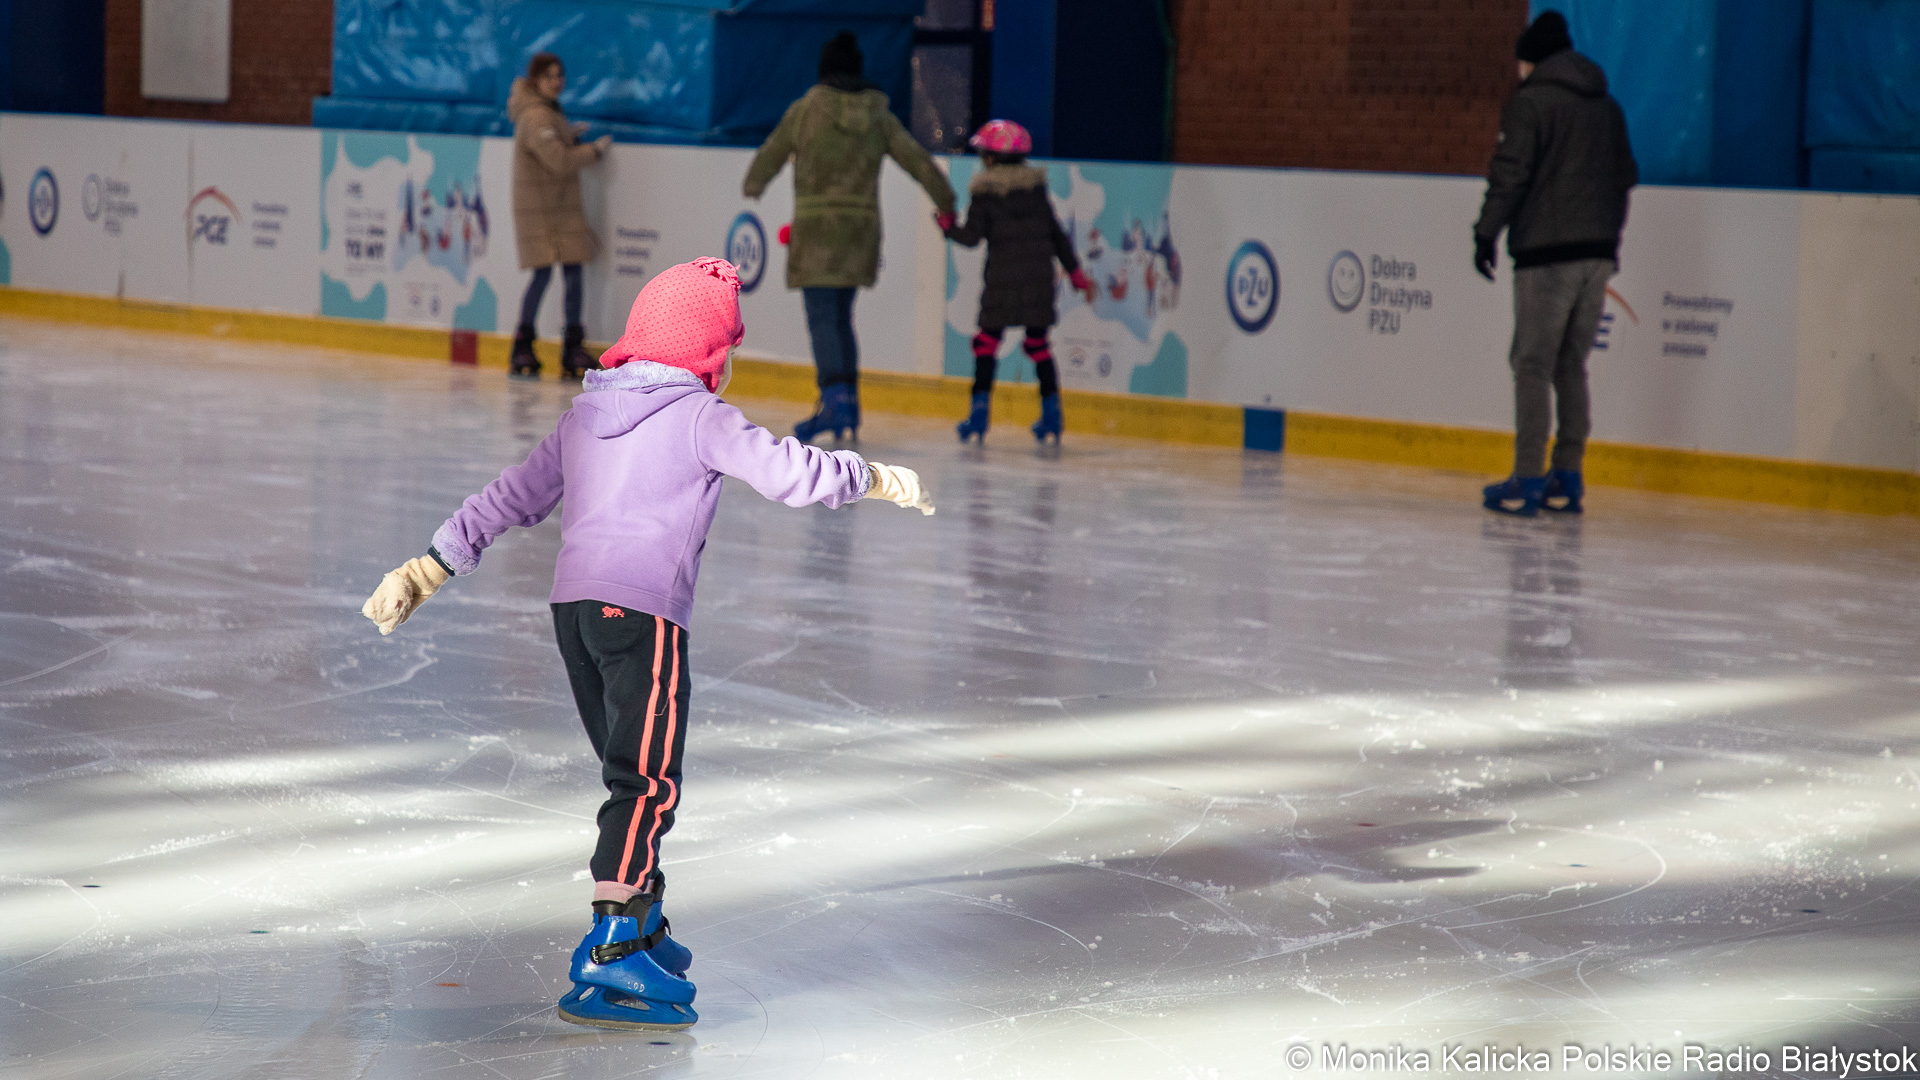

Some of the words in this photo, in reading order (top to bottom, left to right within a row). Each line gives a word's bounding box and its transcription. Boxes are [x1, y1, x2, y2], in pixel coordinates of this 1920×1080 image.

[1370, 253, 1417, 281] Dobra
[1236, 265, 1270, 307] PZU
[1370, 281, 1433, 313] Drużyna
[1369, 309, 1401, 335] PZU
